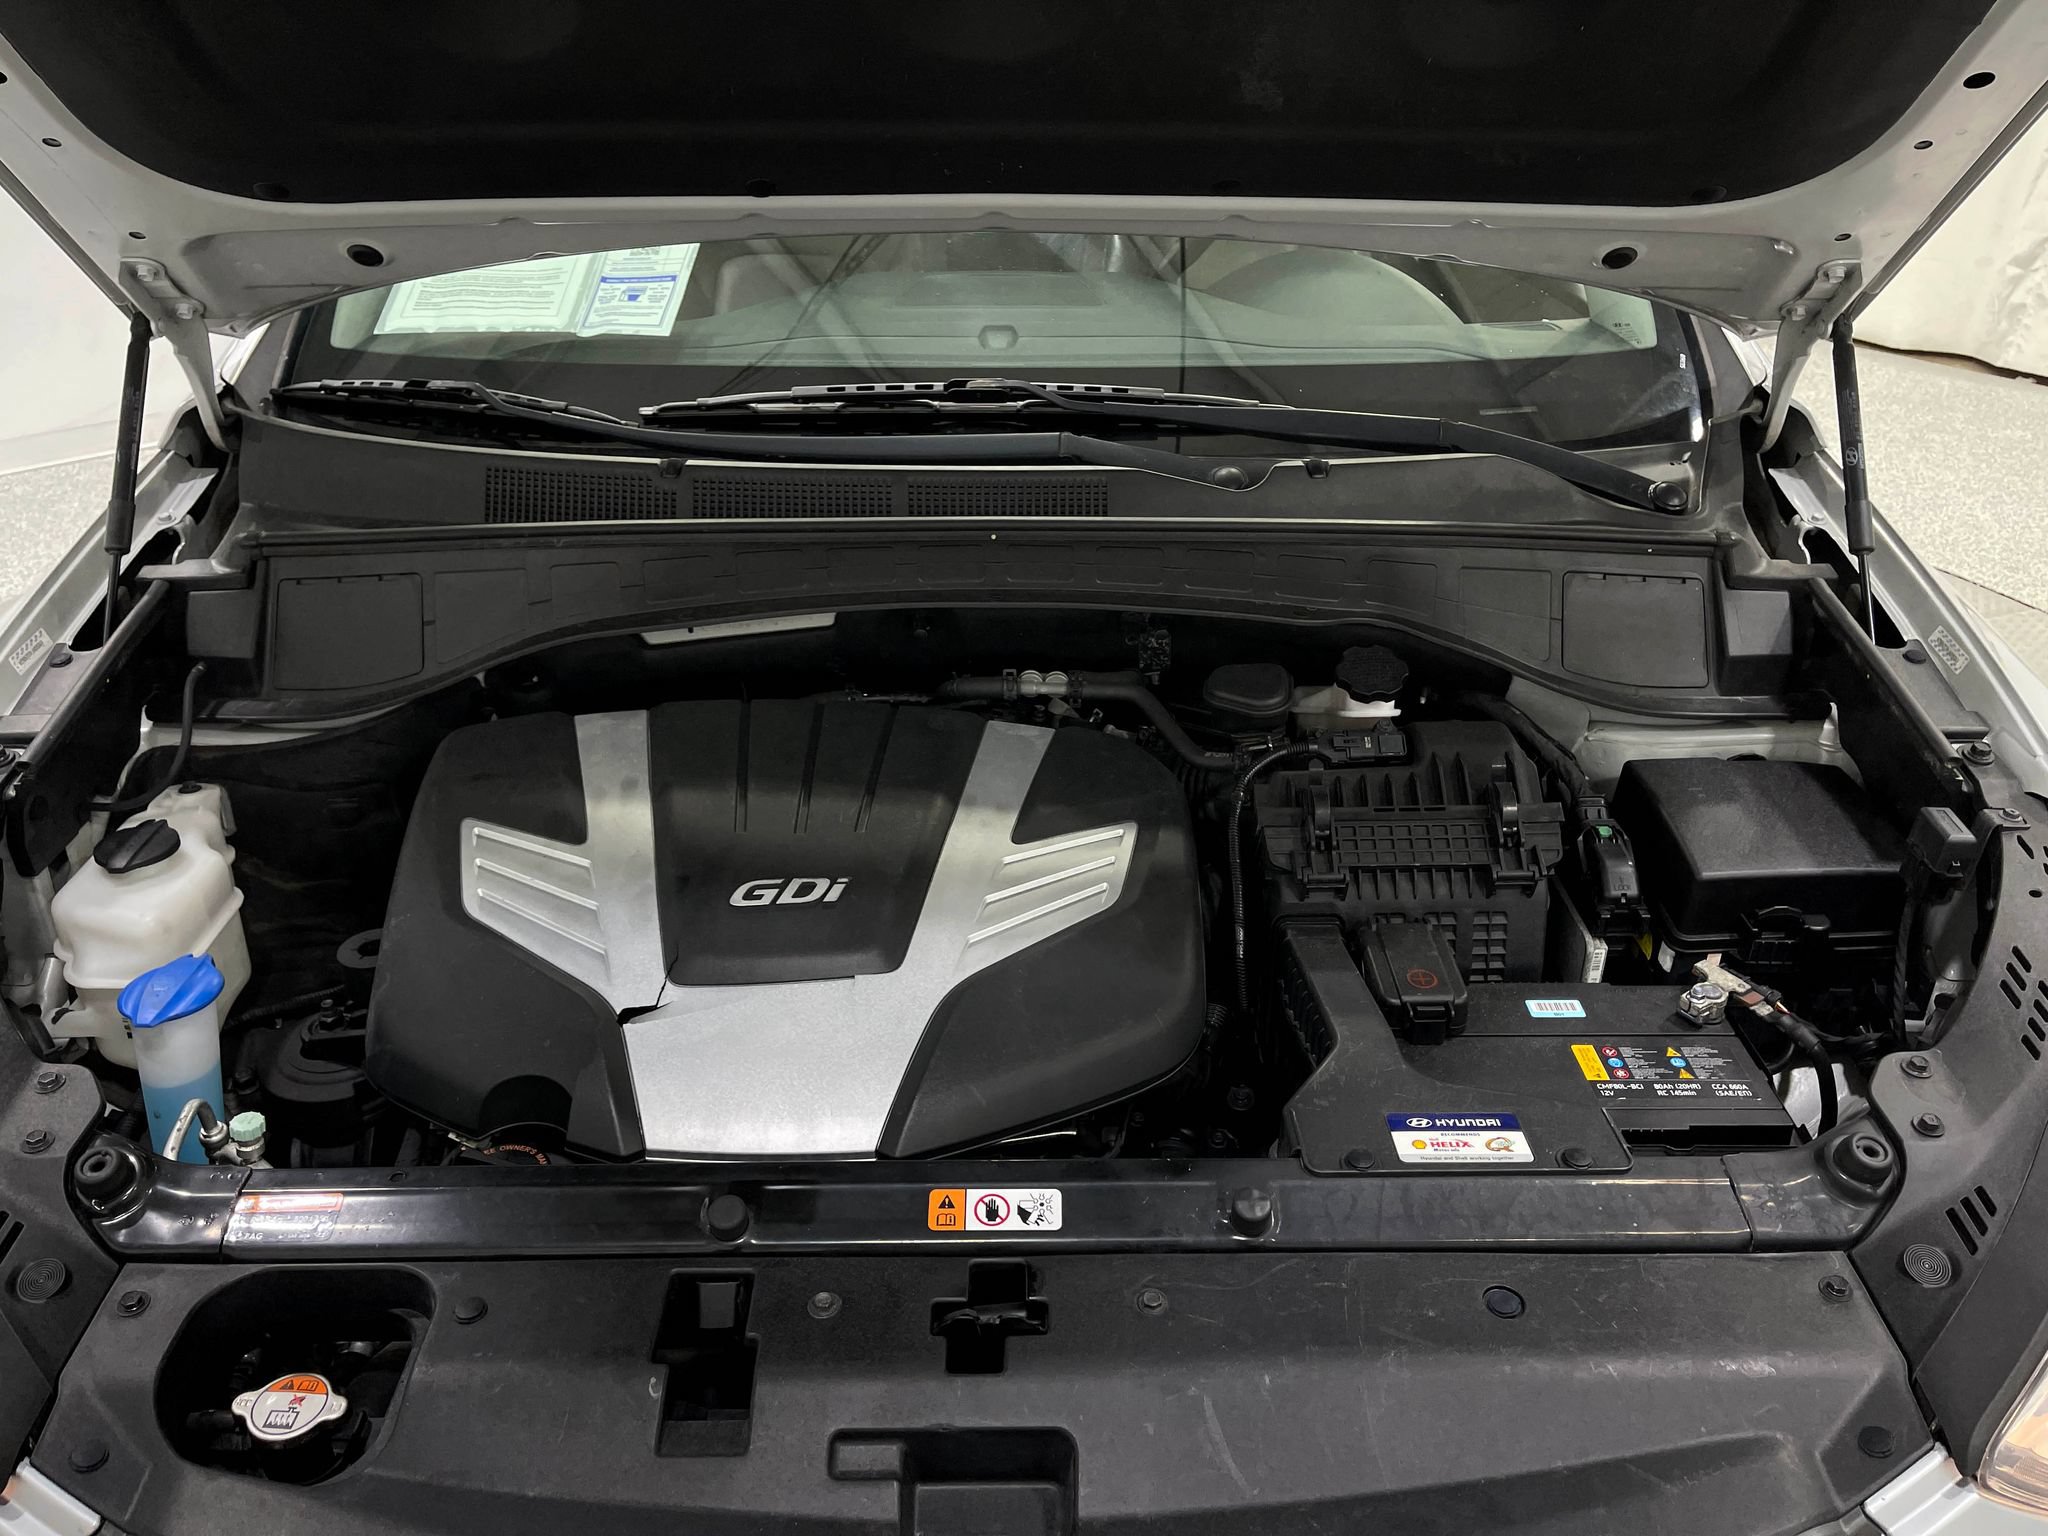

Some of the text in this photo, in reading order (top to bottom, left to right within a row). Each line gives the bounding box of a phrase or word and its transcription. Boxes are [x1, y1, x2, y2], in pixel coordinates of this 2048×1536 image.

[729, 877, 849, 907] GDi
[1435, 1118, 1502, 1127] HYUNDAI
[499, 1144, 538, 1155] OWNER'S
